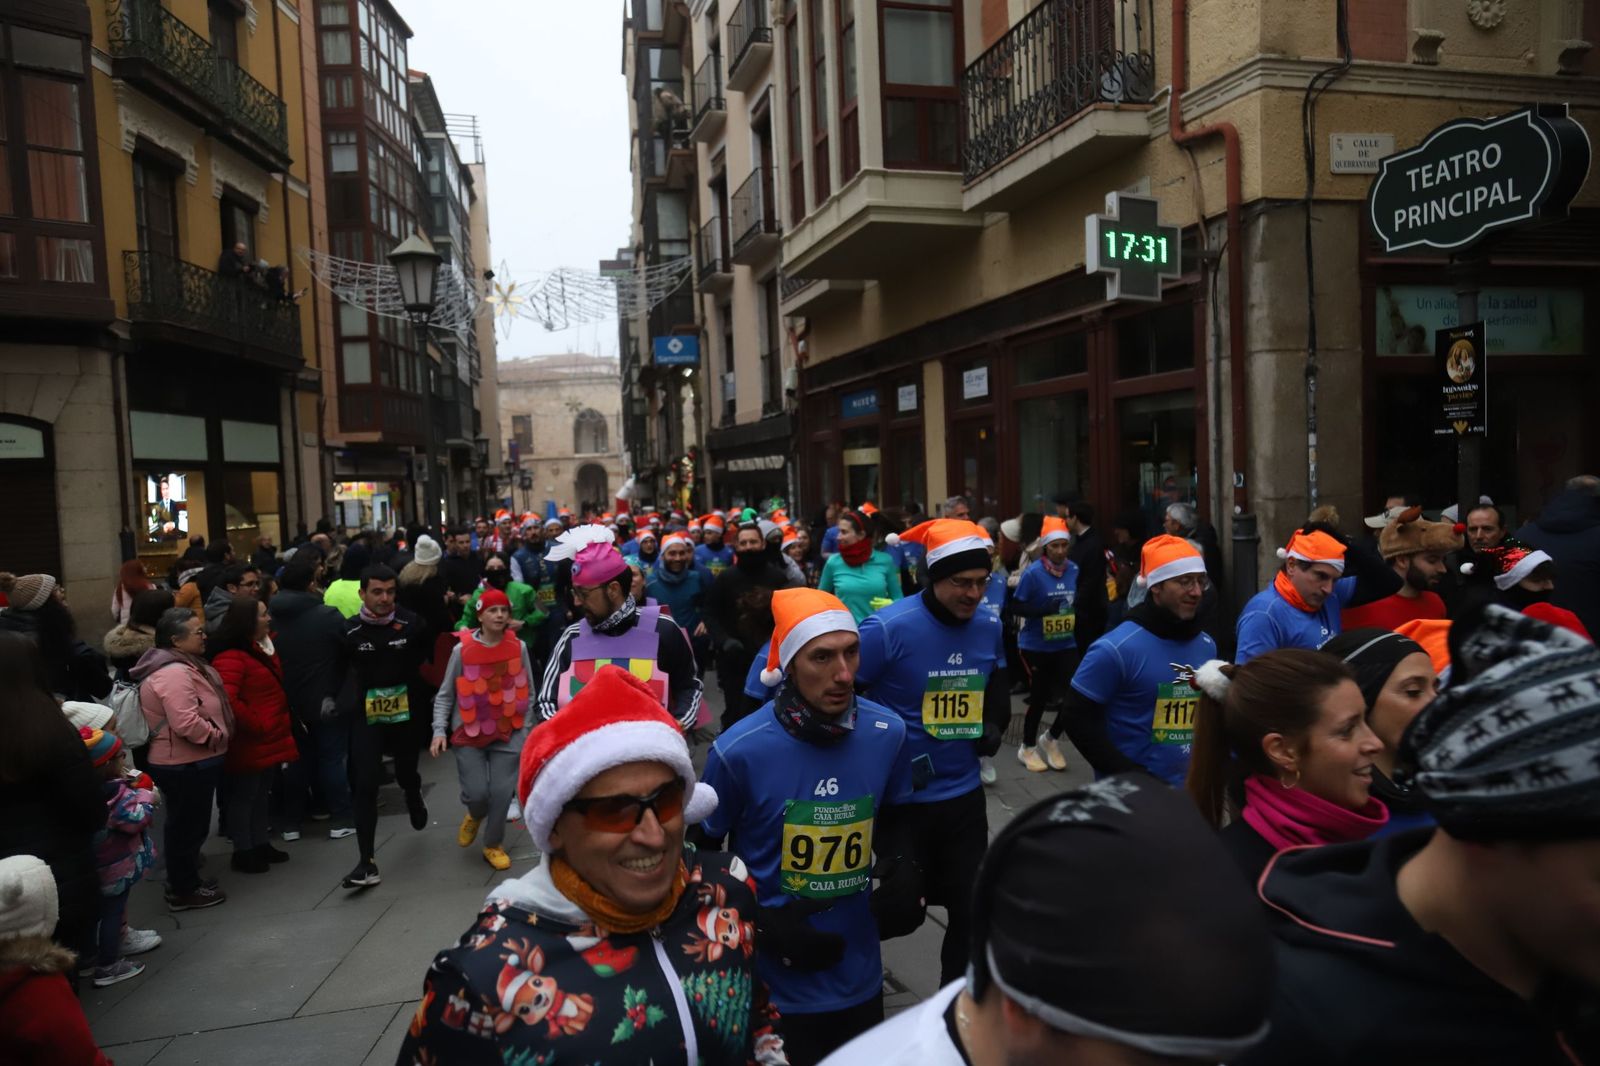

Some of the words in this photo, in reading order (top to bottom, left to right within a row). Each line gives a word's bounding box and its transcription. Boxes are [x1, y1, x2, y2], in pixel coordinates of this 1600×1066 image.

[1353, 139, 1379, 148] CALLE
[1358, 150, 1370, 158] DE
[1335, 160, 1378, 169] QUEBRANTAHU
[1406, 143, 1502, 192] TEATRO
[1394, 178, 1522, 232] PRINCIPAL
[1105, 231, 1167, 263] 17:31
[1488, 296, 1500, 309] la
[1503, 296, 1537, 309] salud
[1046, 618, 1071, 633] 556
[947, 652, 963, 665] 46
[931, 693, 969, 719] 1115
[1163, 701, 1197, 724] 1117
[814, 777, 839, 797] 46
[813, 812, 833, 821] CAJA
[834, 810, 857, 820] RURAL
[790, 832, 862, 872] 976
[809, 880, 836, 892] CAJA
[837, 875, 868, 890] RURAL
